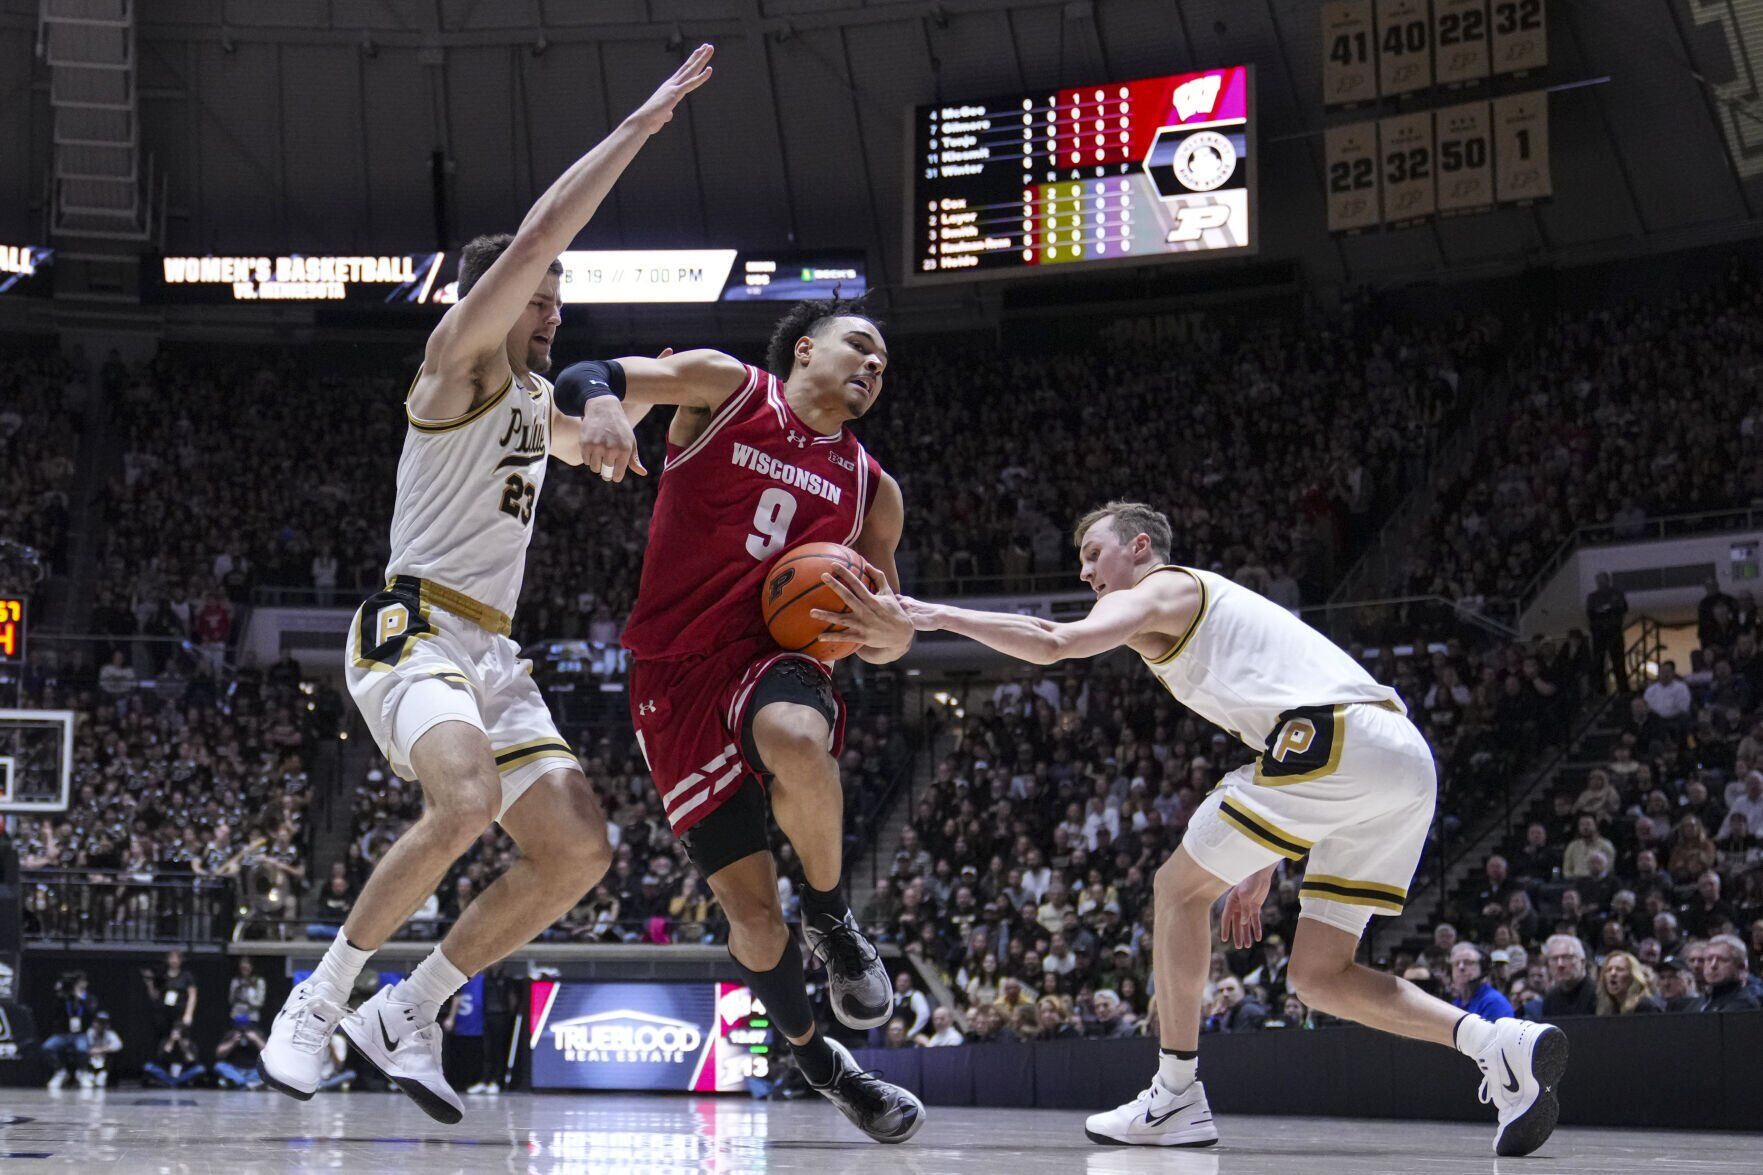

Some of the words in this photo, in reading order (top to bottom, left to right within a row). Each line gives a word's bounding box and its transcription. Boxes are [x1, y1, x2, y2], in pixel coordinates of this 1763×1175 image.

[1439, 9, 1484, 47] 22
[1496, 0, 1541, 36] 32
[1330, 31, 1367, 67] 41
[1382, 20, 1426, 56] 40
[1049, 96, 1055, 107] 1
[1073, 94, 1079, 104] 1
[1098, 105, 1104, 116] 1
[1073, 123, 1079, 133] 1
[1073, 137, 1079, 148] 1
[1515, 129, 1531, 160] 1
[941, 164, 984, 177] Winter
[1049, 155, 1055, 165] 1
[1122, 146, 1128, 157] 1
[1386, 147, 1429, 184] 32
[1441, 137, 1486, 173] 50
[1330, 158, 1374, 194] 22
[929, 216, 937, 226] 2
[1074, 200, 1080, 211] 1
[941, 199, 966, 210] Cox
[163, 257, 271, 283] WOMEN'S
[275, 257, 416, 283] BASKETBALL
[587, 269, 602, 283] 19
[678, 269, 703, 283] PM
[732, 442, 841, 505] WISCONSIN
[499, 472, 535, 526] 23
[745, 487, 797, 561] 9
[376, 602, 410, 648] P
[1272, 717, 1316, 763] P
[550, 1025, 701, 1051] TRUEBLOOD
[564, 1050, 610, 1062] REAL
[616, 1050, 684, 1063] ESTATE
